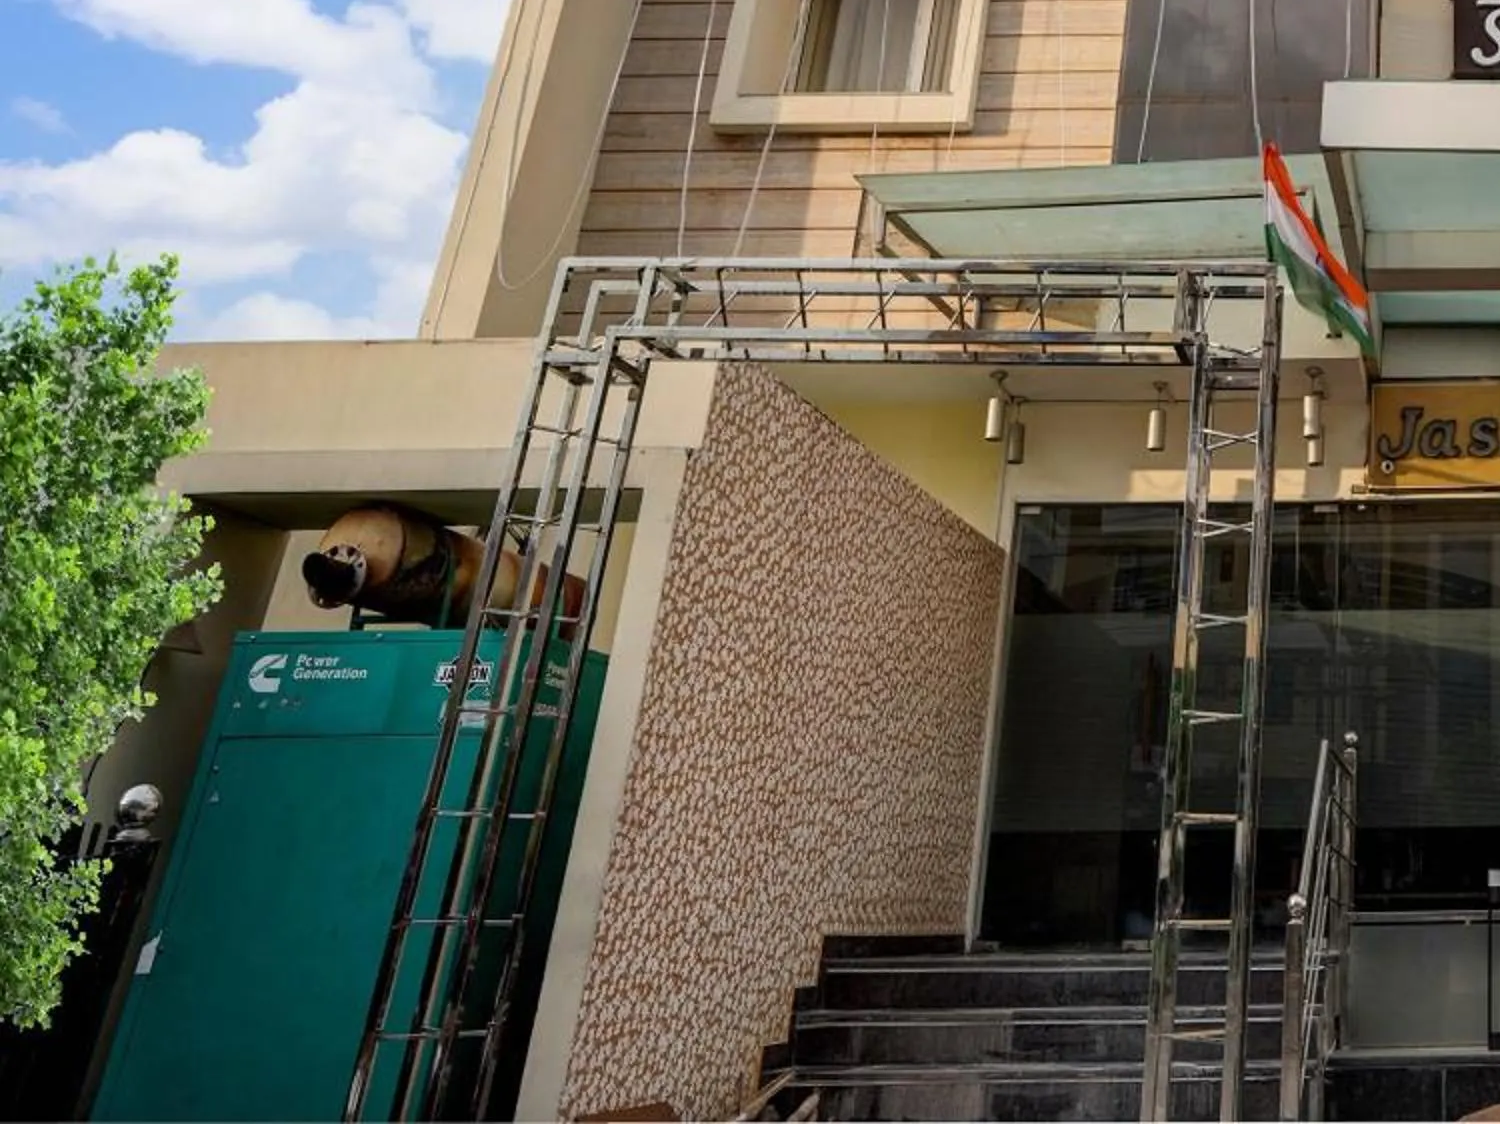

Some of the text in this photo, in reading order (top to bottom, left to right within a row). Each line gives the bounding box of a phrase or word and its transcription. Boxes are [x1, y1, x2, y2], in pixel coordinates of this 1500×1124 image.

[295, 654, 340, 667] Power
[293, 667, 367, 680] Generation
[440, 667, 488, 681] JAON
